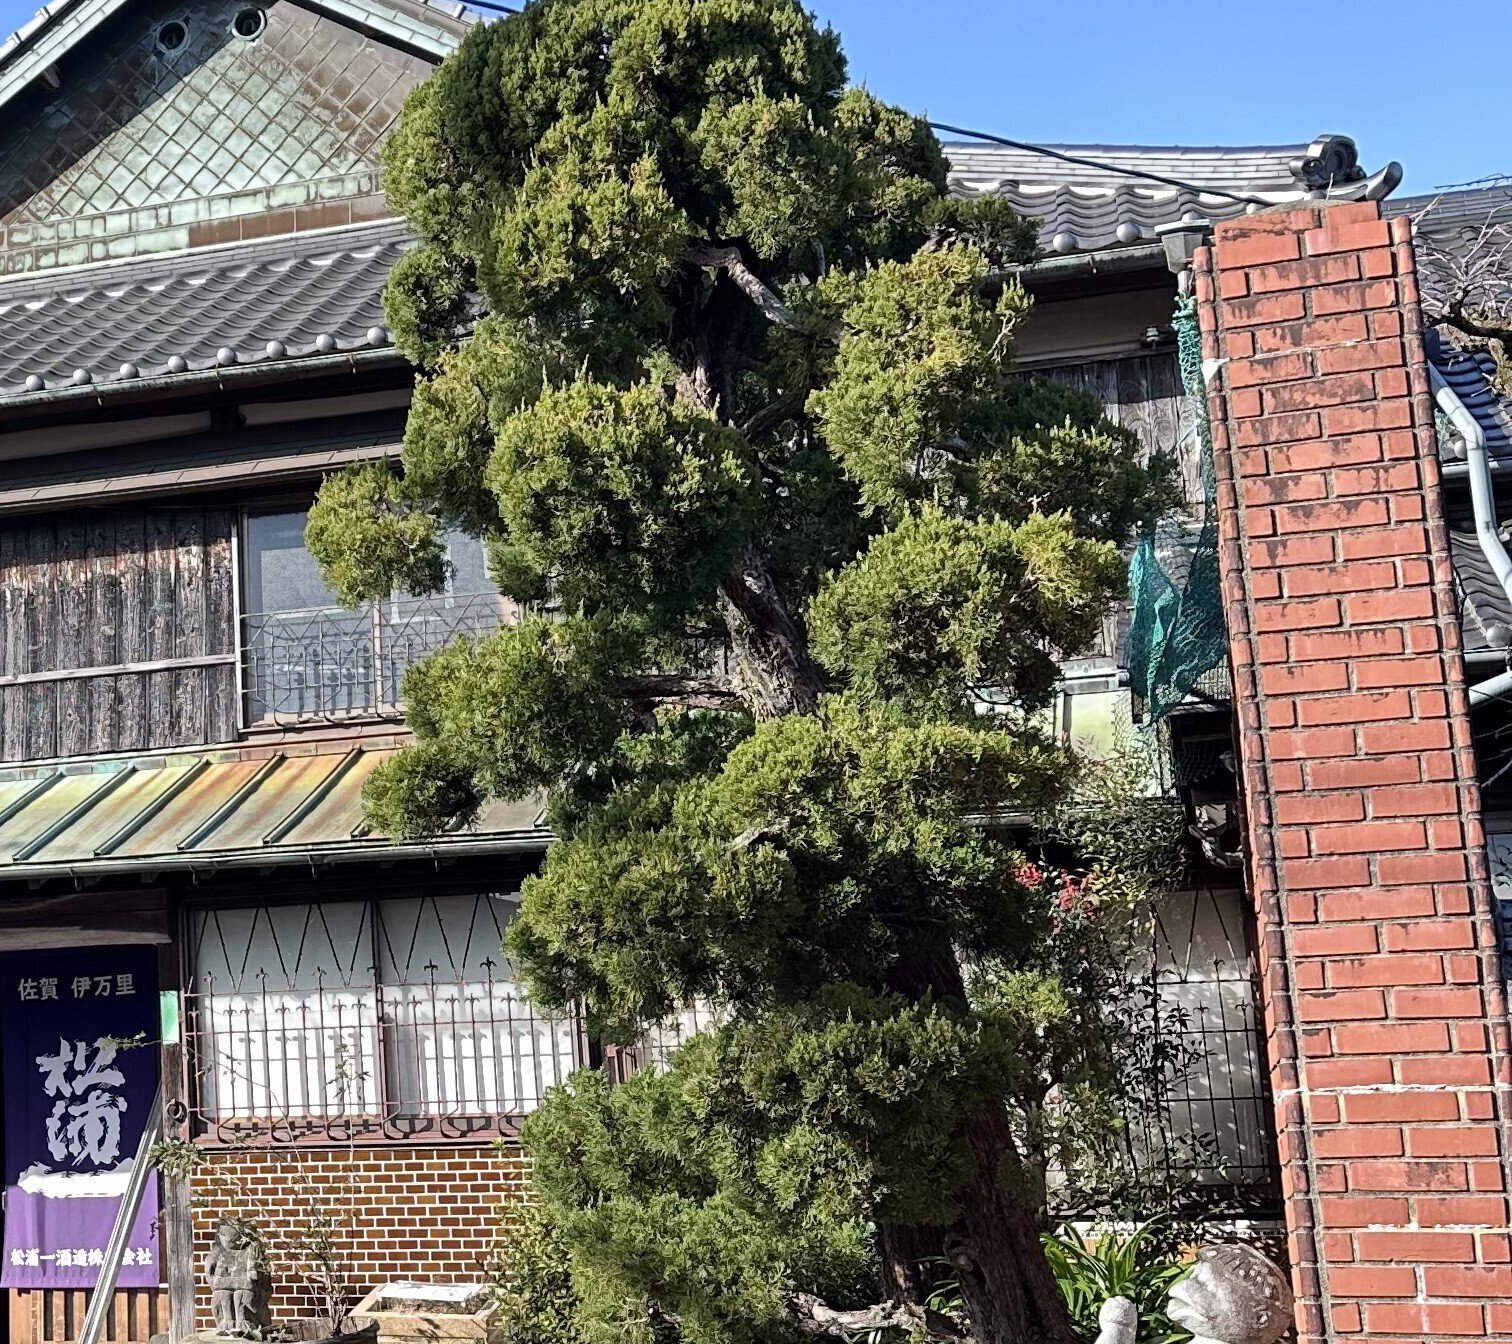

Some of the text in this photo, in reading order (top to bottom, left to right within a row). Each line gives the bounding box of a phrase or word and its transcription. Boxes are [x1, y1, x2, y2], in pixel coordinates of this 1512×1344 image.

[18, 973, 136, 1001] 佐賀 伊万里
[17, 1037, 136, 1199] 松浦一
[11, 1248, 153, 1267] 松浦一酒造株会社
